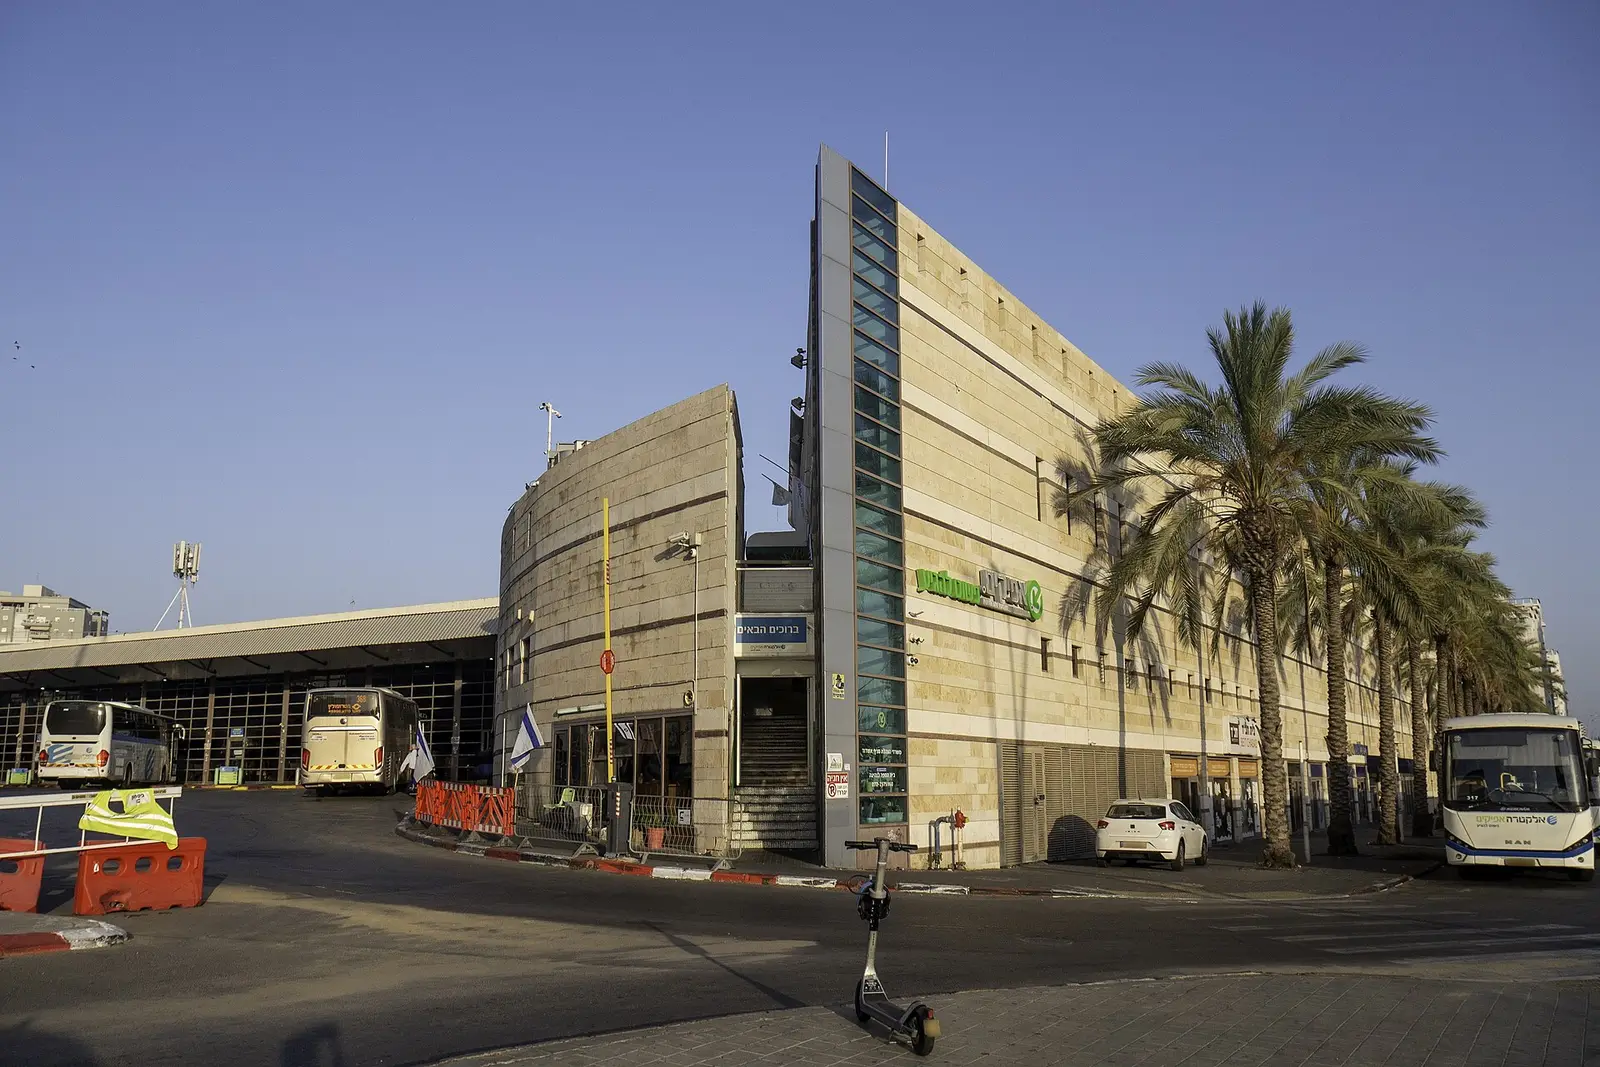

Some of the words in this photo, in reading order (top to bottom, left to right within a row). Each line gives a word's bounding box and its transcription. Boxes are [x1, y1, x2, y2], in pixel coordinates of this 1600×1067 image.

[737, 625, 766, 634] הבאים
[769, 625, 799, 634] ברוכים
[827, 775, 840, 783] חניה
[840, 775, 848, 784] אין
[1476, 815, 1506, 824] אפיקים
[1506, 815, 1546, 825] אלקטרה
